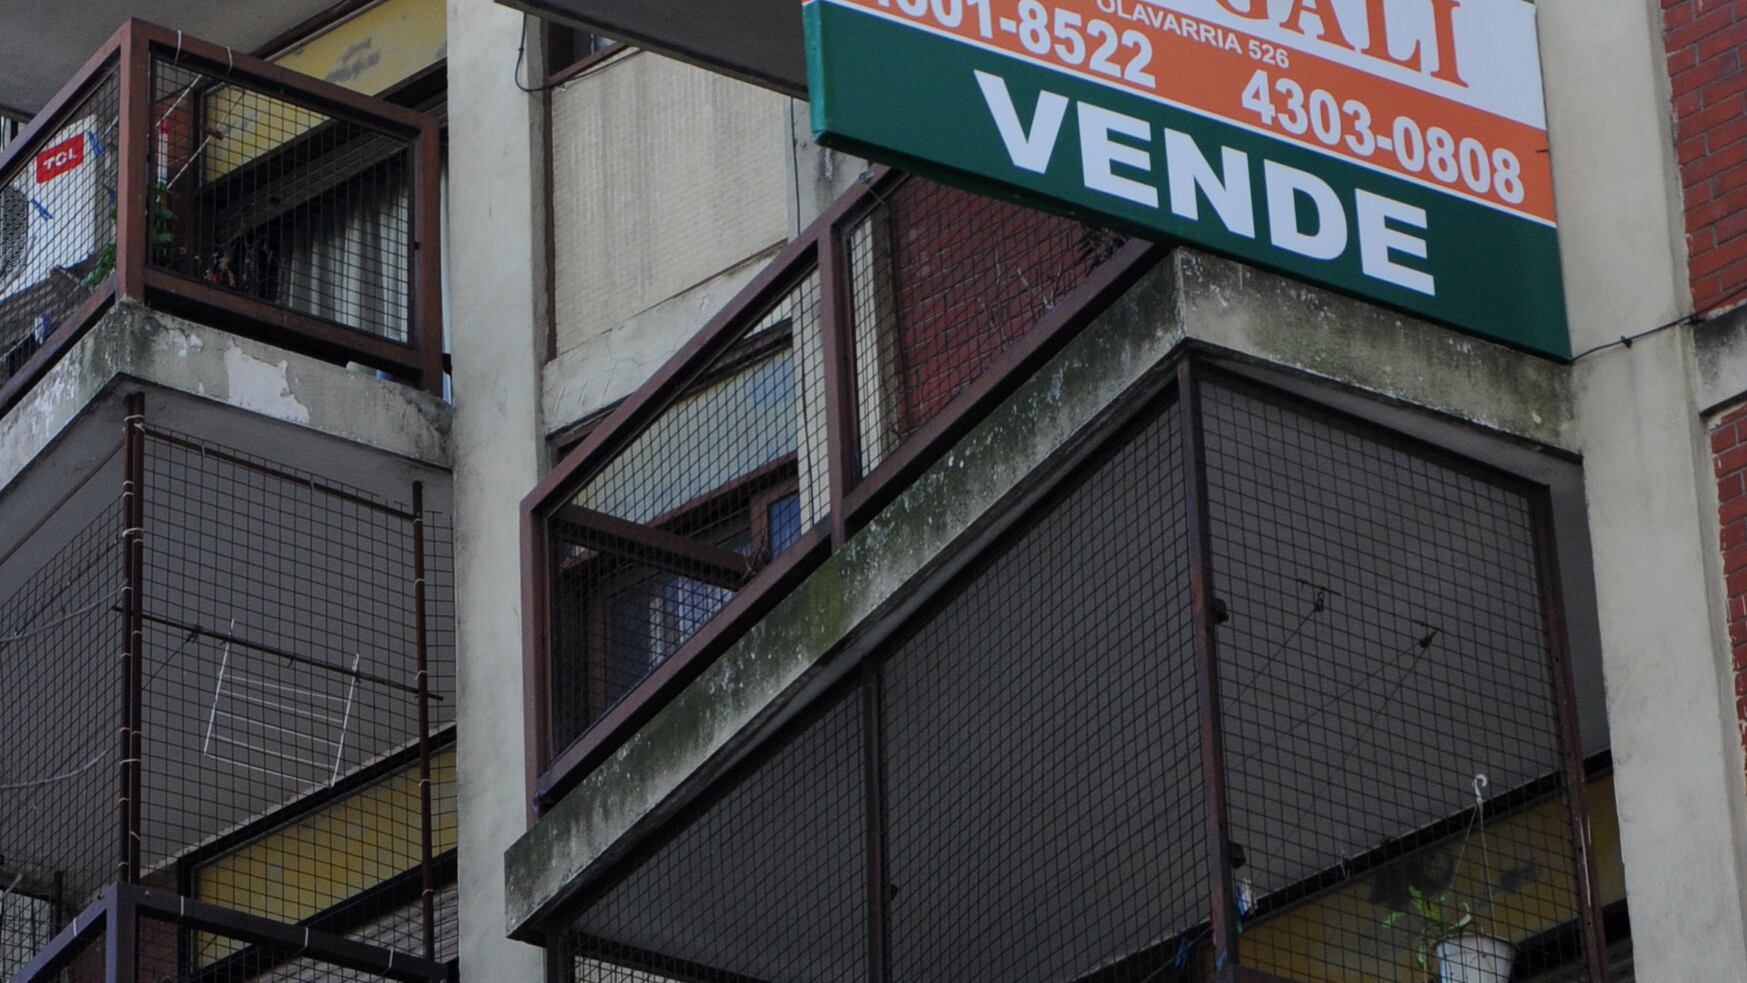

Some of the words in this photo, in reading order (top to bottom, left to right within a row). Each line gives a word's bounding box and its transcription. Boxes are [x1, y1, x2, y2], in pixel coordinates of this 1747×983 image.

[1097, 0, 1243, 55] OLAVARRIA
[1247, 39, 1290, 69] 526
[1212, 0, 1469, 89] ALI
[878, 0, 1156, 89] 01-8522
[1241, 69, 1526, 205] 4303-0808
[42, 147, 78, 170] TCL
[973, 69, 1436, 297] VENDE
